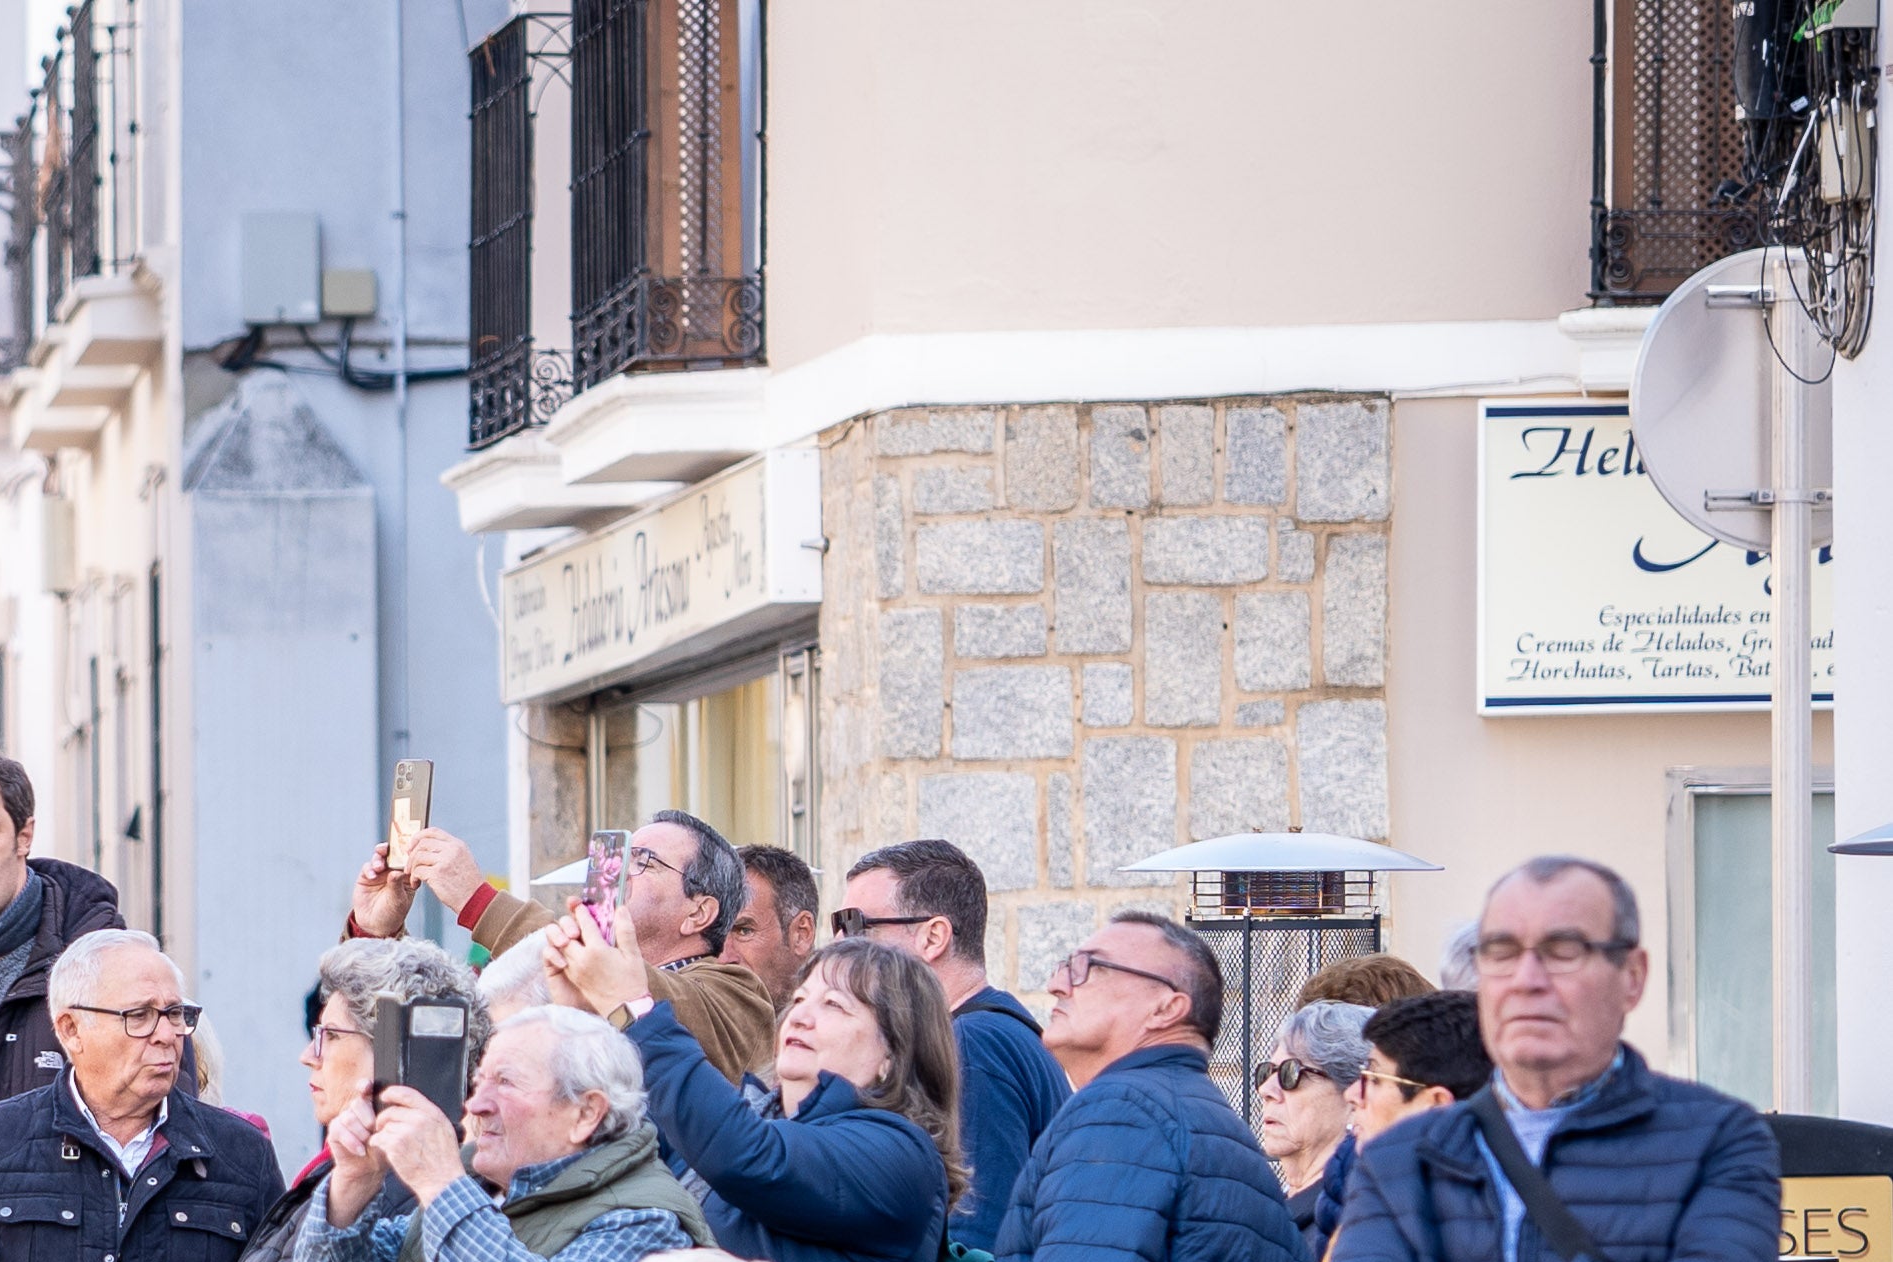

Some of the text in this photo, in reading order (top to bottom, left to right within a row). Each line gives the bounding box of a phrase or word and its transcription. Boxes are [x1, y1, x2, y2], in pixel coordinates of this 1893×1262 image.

[1598, 603, 1771, 633] Especialidades en
[1516, 631, 1595, 654] Cremas
[1602, 631, 1625, 651] de
[1630, 629, 1732, 653] Helados,
[1505, 657, 1633, 681] Horchatas,
[1641, 656, 1720, 680] Tartas,
